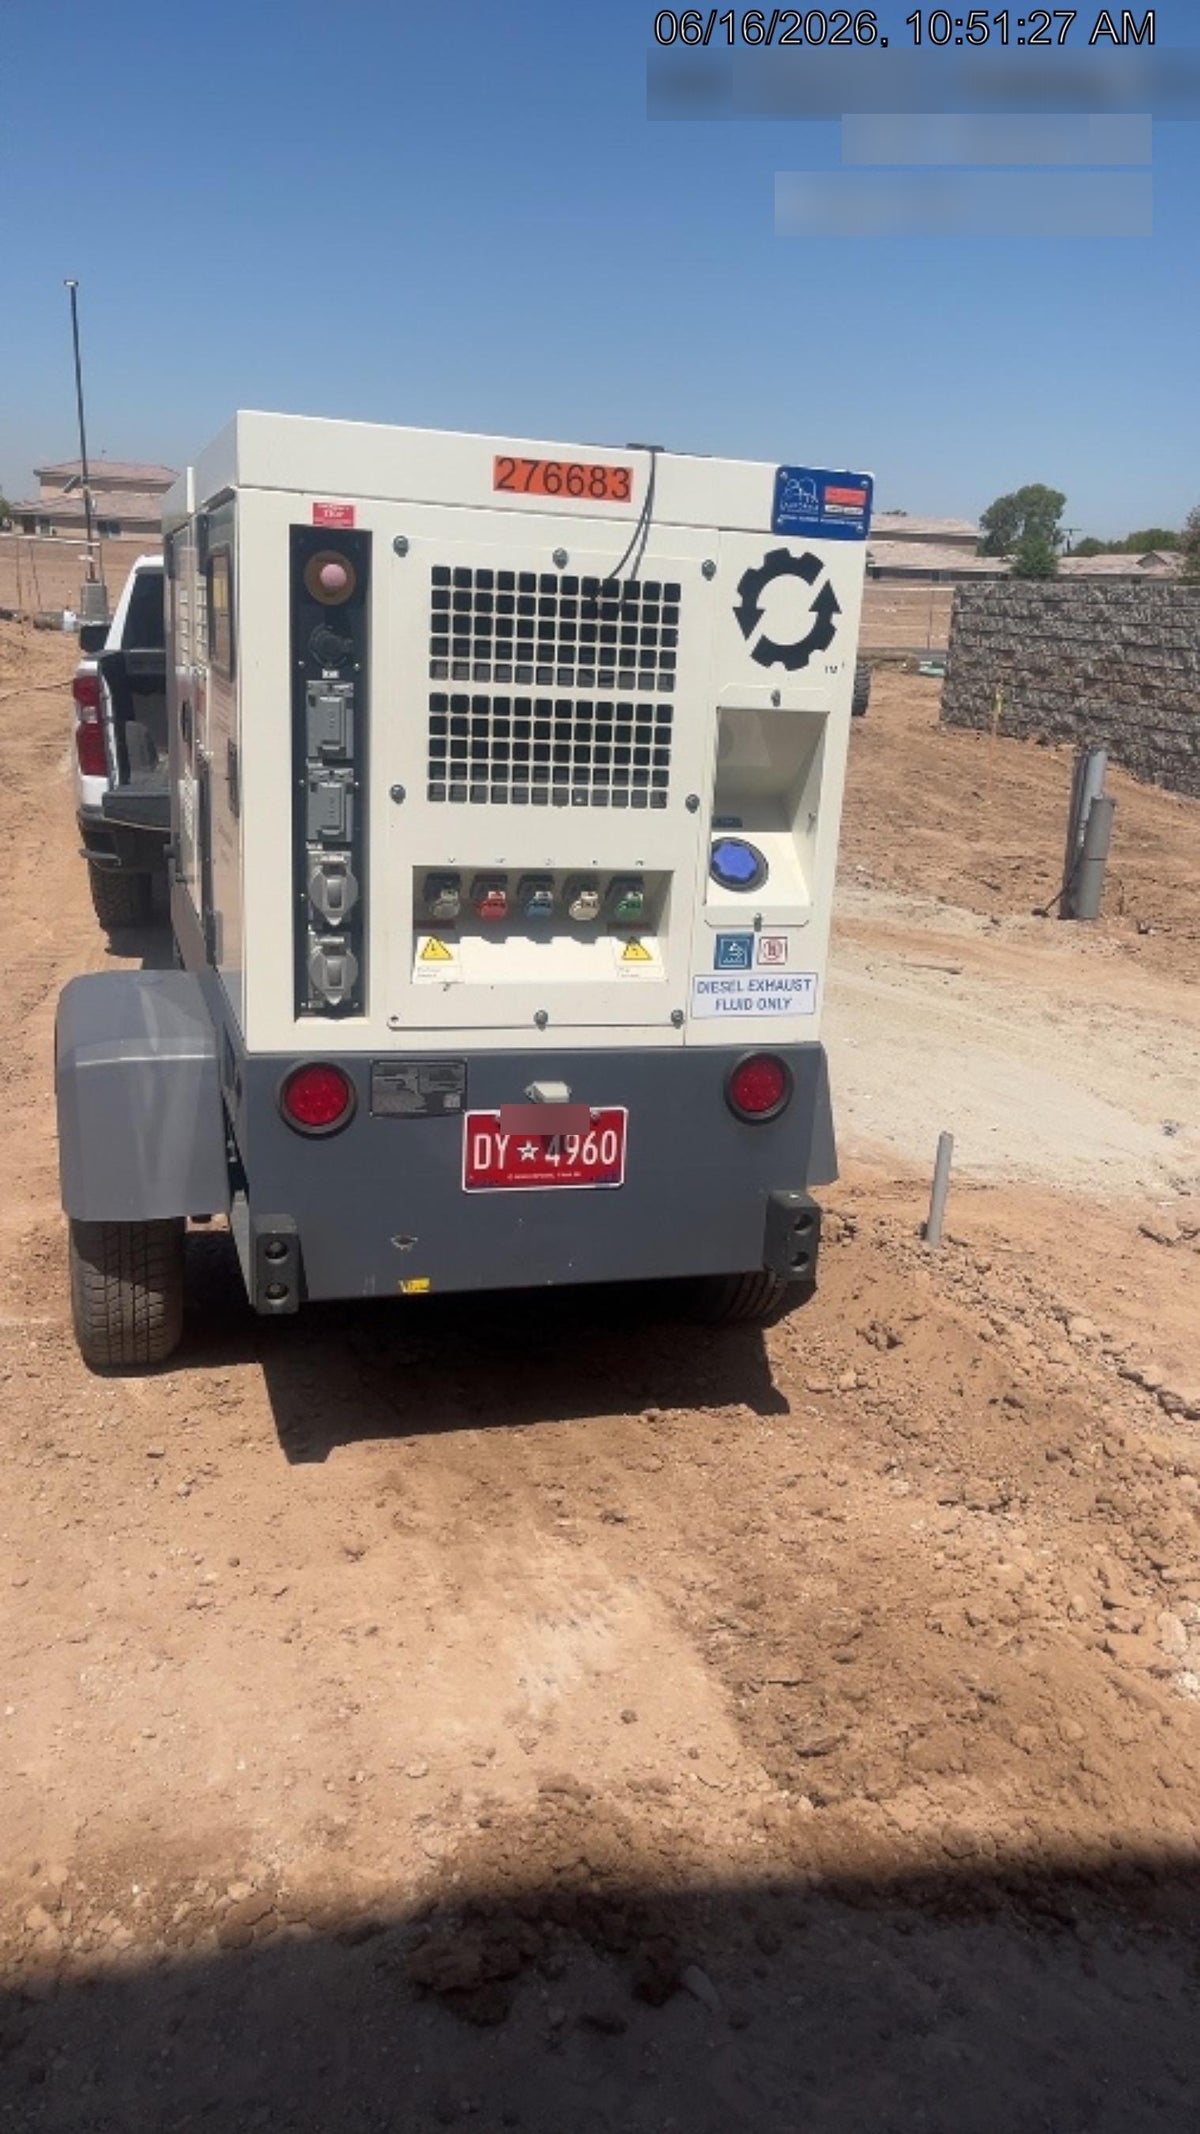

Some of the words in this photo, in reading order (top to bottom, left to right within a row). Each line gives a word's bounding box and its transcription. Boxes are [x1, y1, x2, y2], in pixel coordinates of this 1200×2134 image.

[496, 457, 631, 500] 276683
[696, 980, 745, 995] DIESEL
[747, 979, 812, 993] EXHAUST
[715, 997, 752, 1011] FLUID
[756, 997, 793, 1011] ONLY
[473, 1132, 510, 1170] DY
[544, 1130, 618, 1168] 4960
